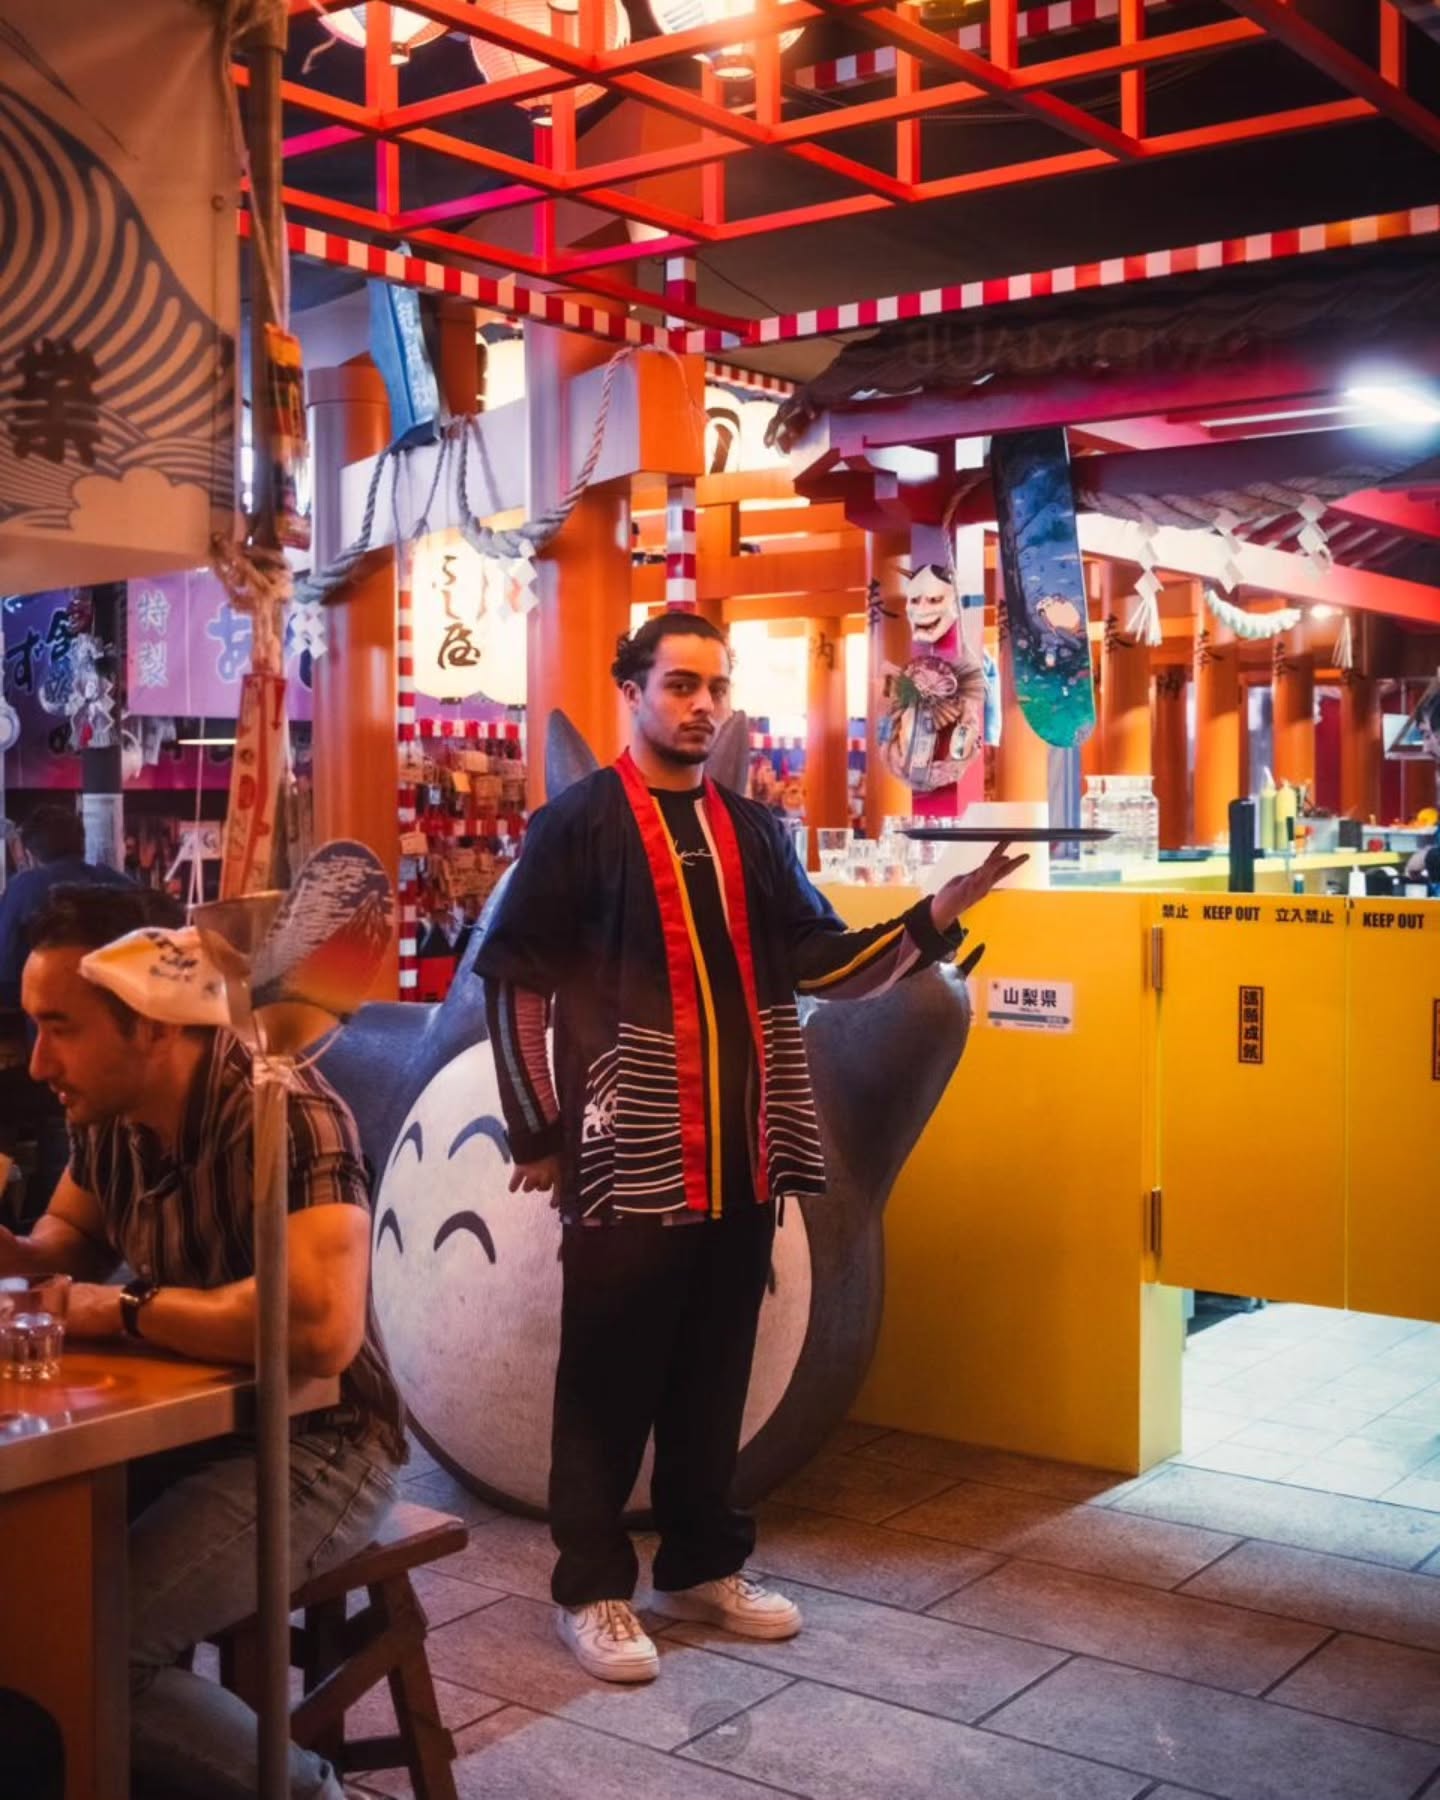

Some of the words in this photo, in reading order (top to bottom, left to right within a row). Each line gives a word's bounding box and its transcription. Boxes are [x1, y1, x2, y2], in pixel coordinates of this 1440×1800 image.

[138, 589, 170, 689] 特製
[1162, 904, 1189, 920] 禁止
[1203, 905, 1233, 921] KEEP
[1235, 906, 1261, 922] OUT
[1275, 908, 1334, 925] 立入禁止
[1363, 911, 1395, 929] KEEP
[1397, 913, 1425, 930] OUT
[1003, 987, 1057, 1008] 山梨県
